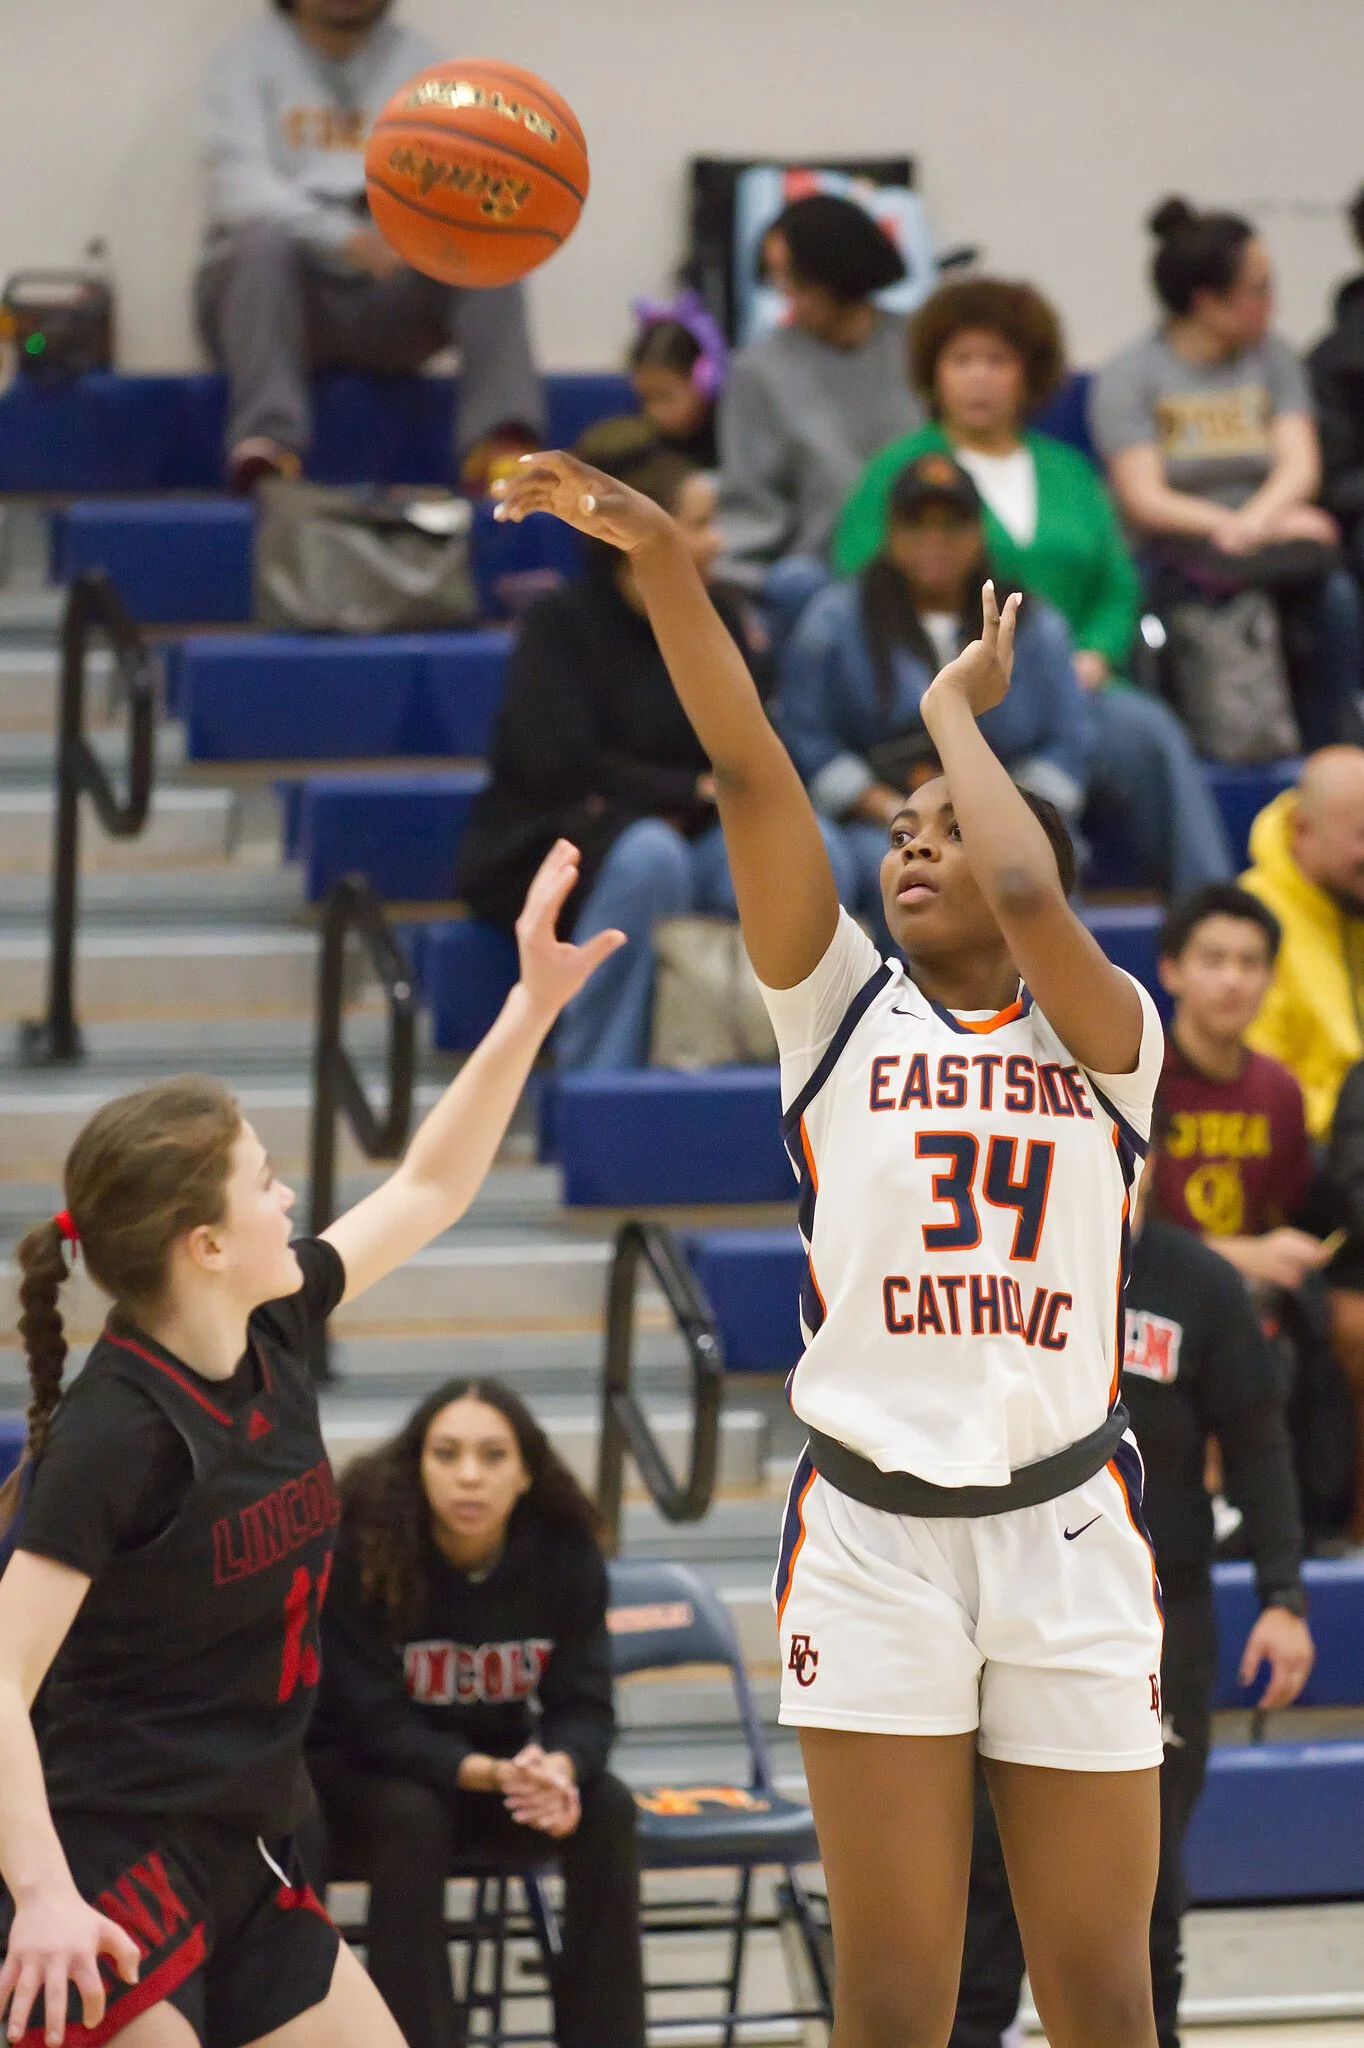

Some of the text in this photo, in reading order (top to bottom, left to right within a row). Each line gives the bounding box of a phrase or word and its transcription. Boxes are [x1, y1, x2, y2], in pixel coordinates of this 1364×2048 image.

[869, 1053, 1095, 1120] EASTSIDE
[914, 1131, 1056, 1262] 34
[882, 1275, 1073, 1352] CATHOIC
[788, 1633, 819, 1688] EC
